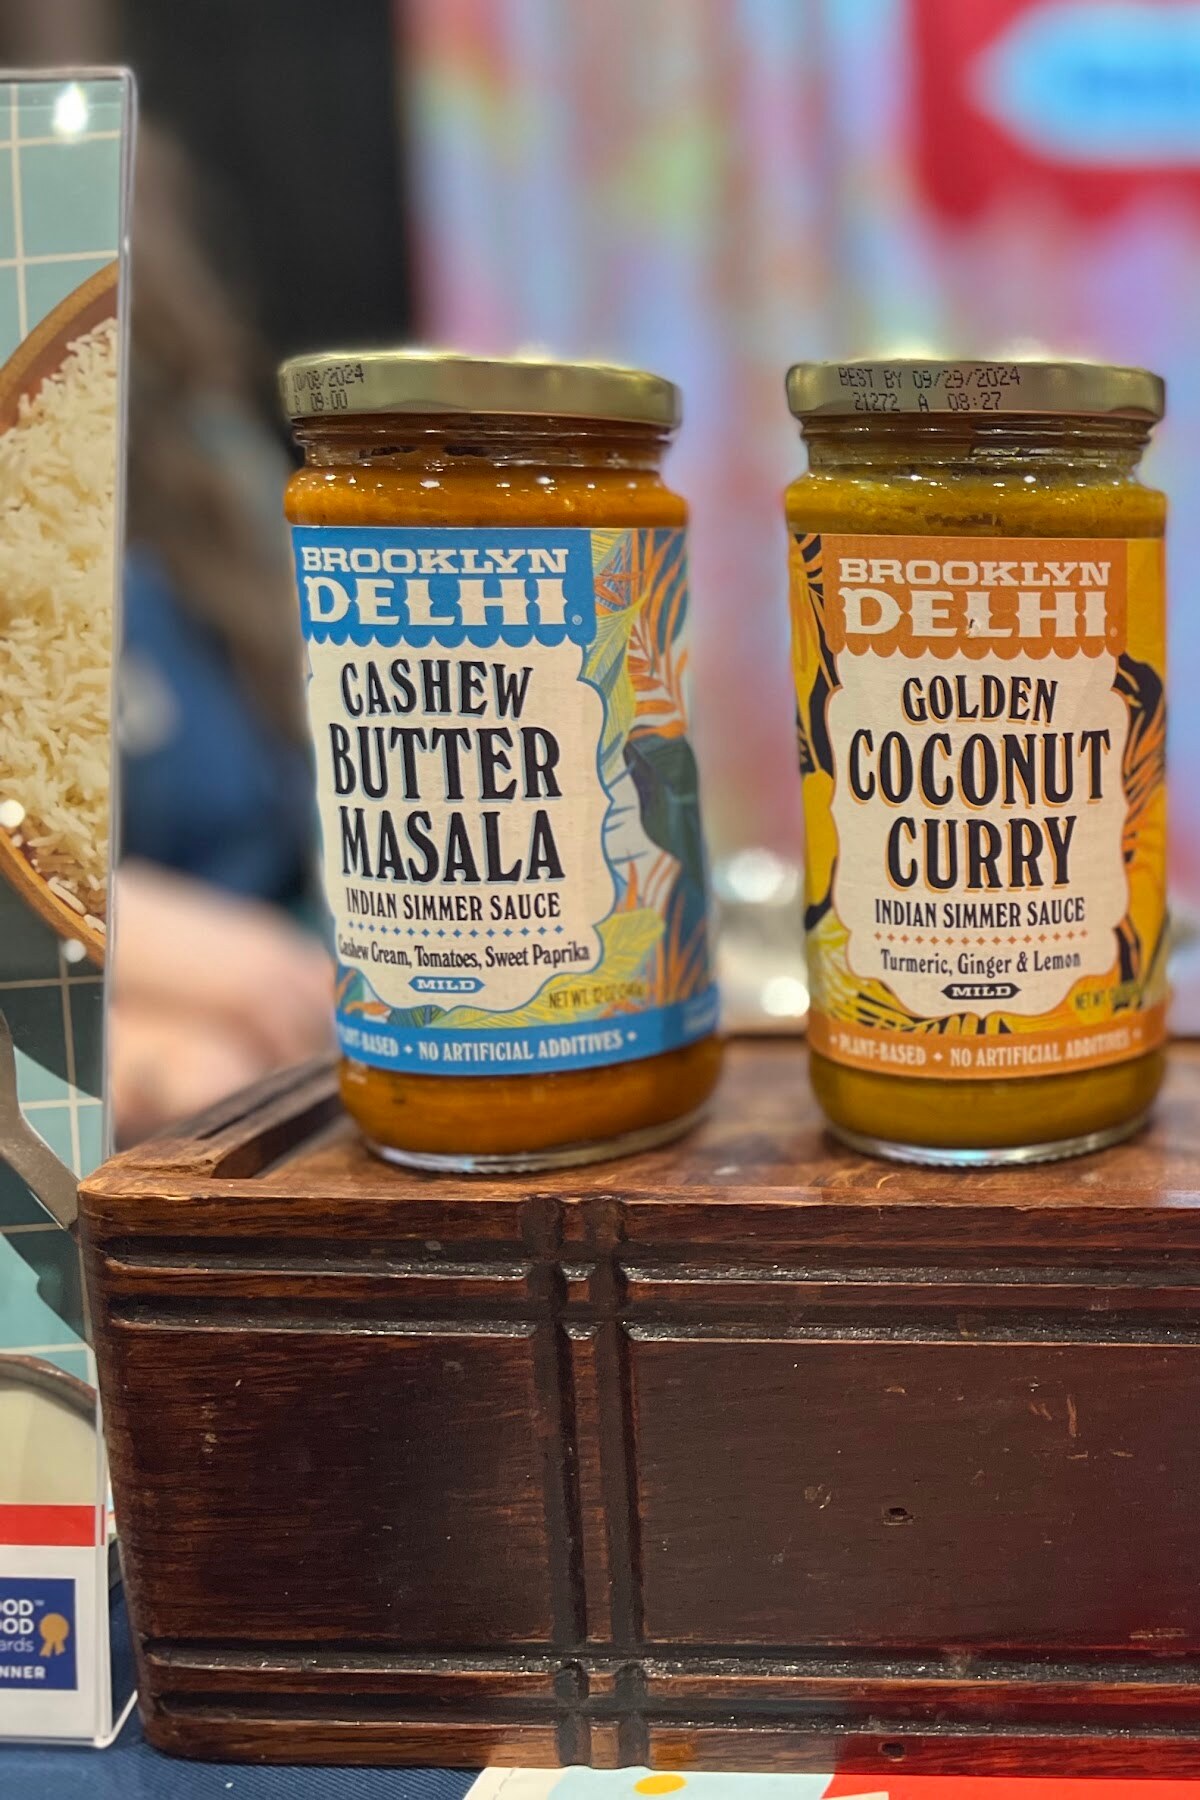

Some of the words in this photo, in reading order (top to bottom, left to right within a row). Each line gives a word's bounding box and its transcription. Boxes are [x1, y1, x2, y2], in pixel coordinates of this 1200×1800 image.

[838, 367, 873, 388] BEST
[884, 370, 901, 389] BY
[912, 366, 1020, 389] 09/29/2024
[853, 392, 900, 411] 21272
[919, 393, 929, 411] A
[947, 392, 1001, 411] 08:27
[302, 547, 568, 573] BROOKLYN
[839, 558, 1111, 586] BROOKLYN
[341, 658, 533, 719] CASHEW
[901, 674, 1058, 726] GOLDEN
[329, 723, 562, 801] BUTTER
[849, 729, 1111, 808] COCONUT
[339, 806, 566, 885] MASALA
[884, 815, 1077, 893] CURRY
[346, 887, 398, 919] INDIAN
[403, 894, 483, 921] SIMMER
[490, 892, 561, 920] SAUCE
[875, 898, 937, 928] INDIAN
[943, 903, 1022, 929] SIMMER
[1027, 897, 1085, 926] SAUCE
[371, 941, 412, 968] Cream,
[414, 945, 482, 970] Tomatoes,
[485, 946, 529, 966] Sweet
[533, 941, 590, 968] Paprika
[880, 948, 953, 977] Turmeric,
[957, 952, 1012, 979] Ginger
[1017, 951, 1028, 973] &
[1033, 951, 1082, 972] Lemon
[417, 979, 476, 990] MILD
[550, 991, 568, 1008] NET
[951, 985, 1013, 997] MILD
[417, 1041, 439, 1060] NO
[443, 1040, 534, 1061] ARTIFICIAL
[538, 1029, 623, 1058] ADDITIVES
[839, 1033, 926, 1066] PLANT-BASED
[951, 1048, 972, 1067] NO
[975, 1040, 1062, 1068] ARTIFICIAL
